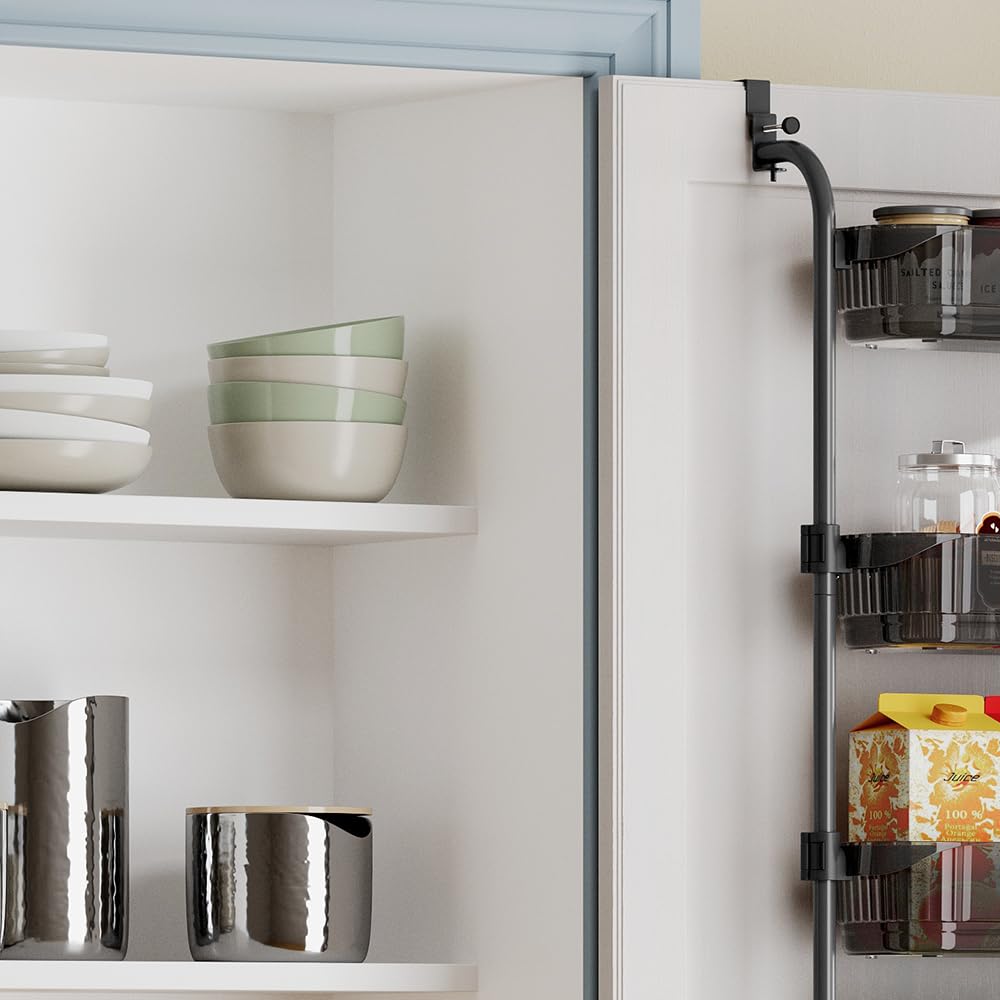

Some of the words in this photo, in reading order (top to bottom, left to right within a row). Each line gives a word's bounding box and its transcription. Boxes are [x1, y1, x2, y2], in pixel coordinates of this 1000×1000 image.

[980, 284, 997, 294] ICE
[943, 772, 981, 782] Juice
[945, 810, 968, 820] 100
[972, 810, 983, 820] %
